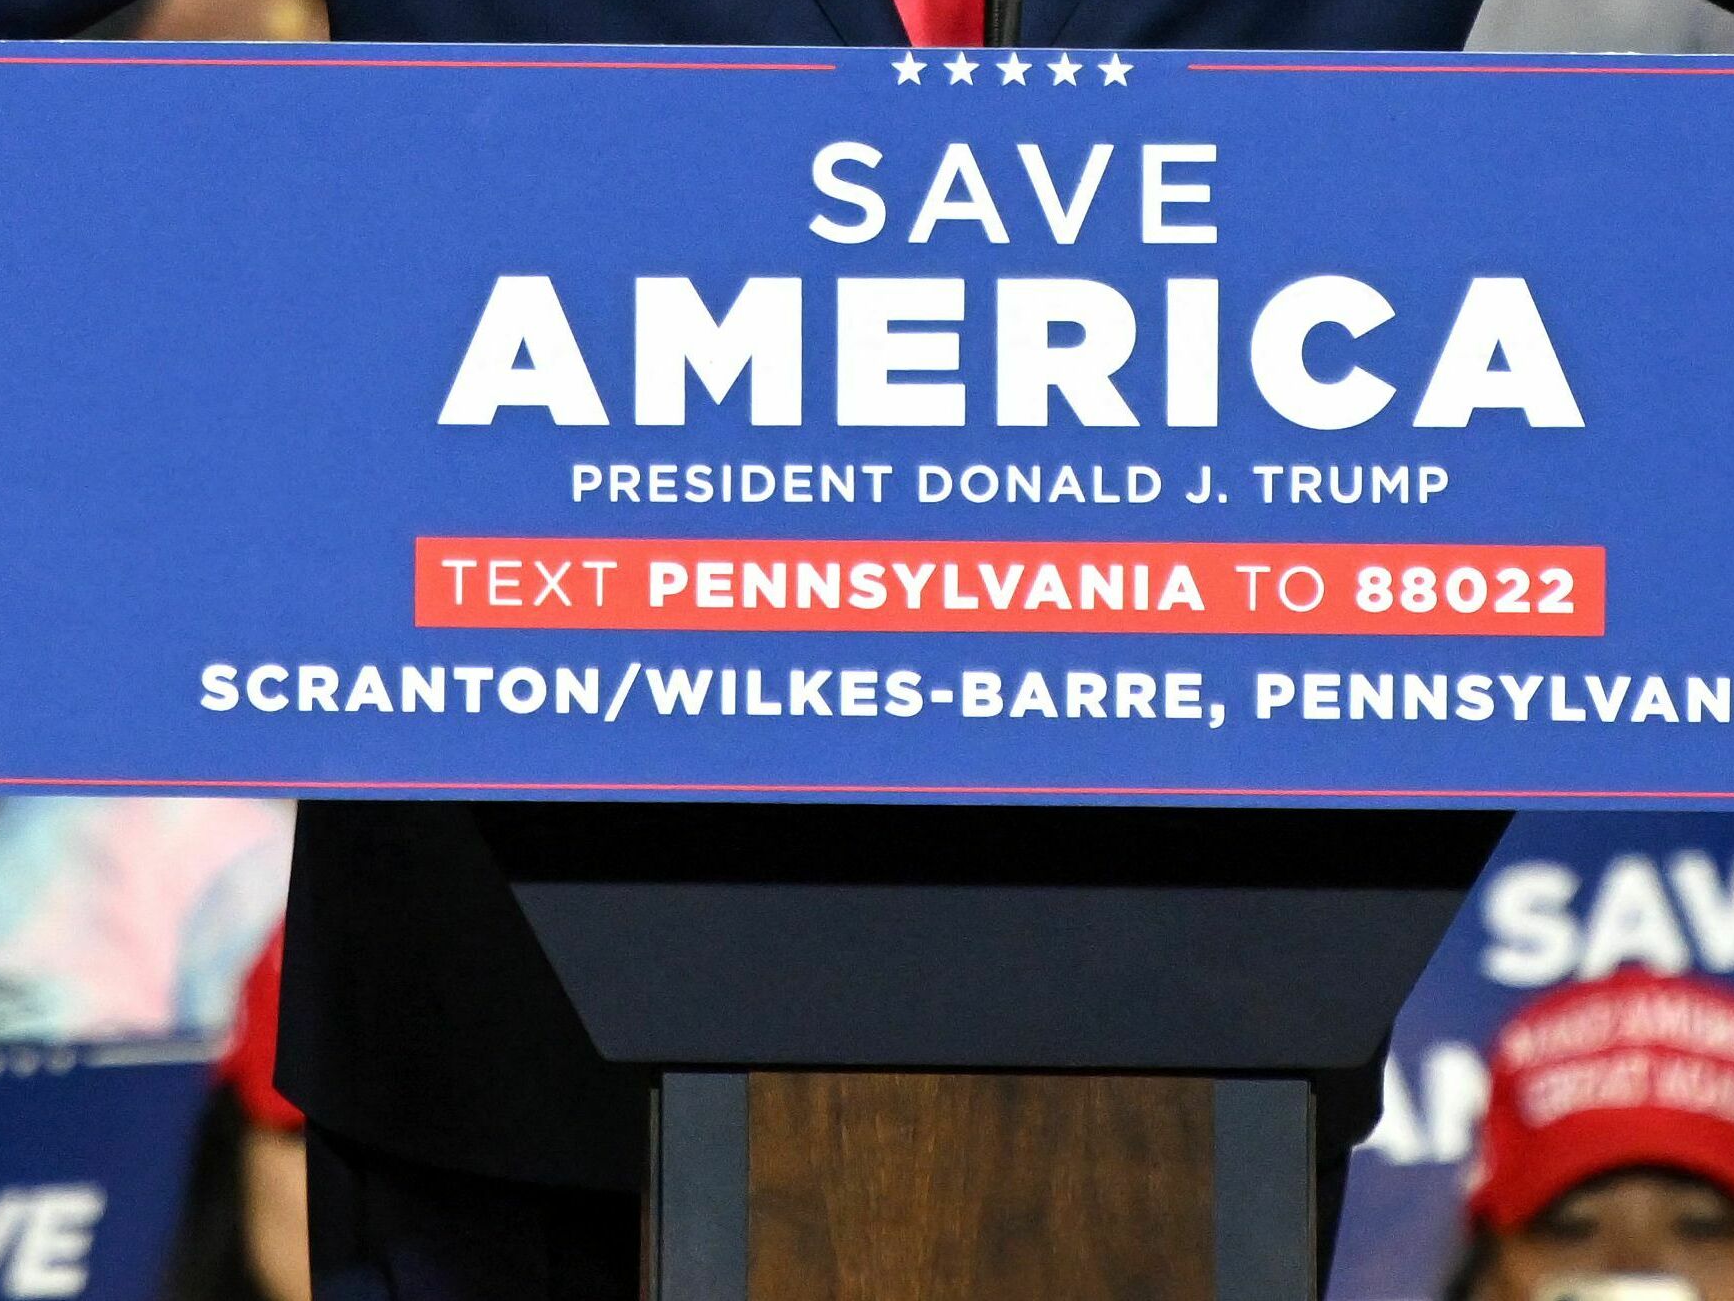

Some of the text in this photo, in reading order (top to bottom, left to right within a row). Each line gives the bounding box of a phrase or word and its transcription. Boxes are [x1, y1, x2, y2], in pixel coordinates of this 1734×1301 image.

[808, 139, 1220, 247] SAVE
[438, 273, 1586, 431] AMERICA
[570, 463, 1450, 506] PRESIDENT DONALD J. TRUMP
[440, 557, 1575, 616] TEXT PENNSYLVANIA TO 88022
[199, 661, 1227, 730] SCRANTON/WILKES-BARRE,
